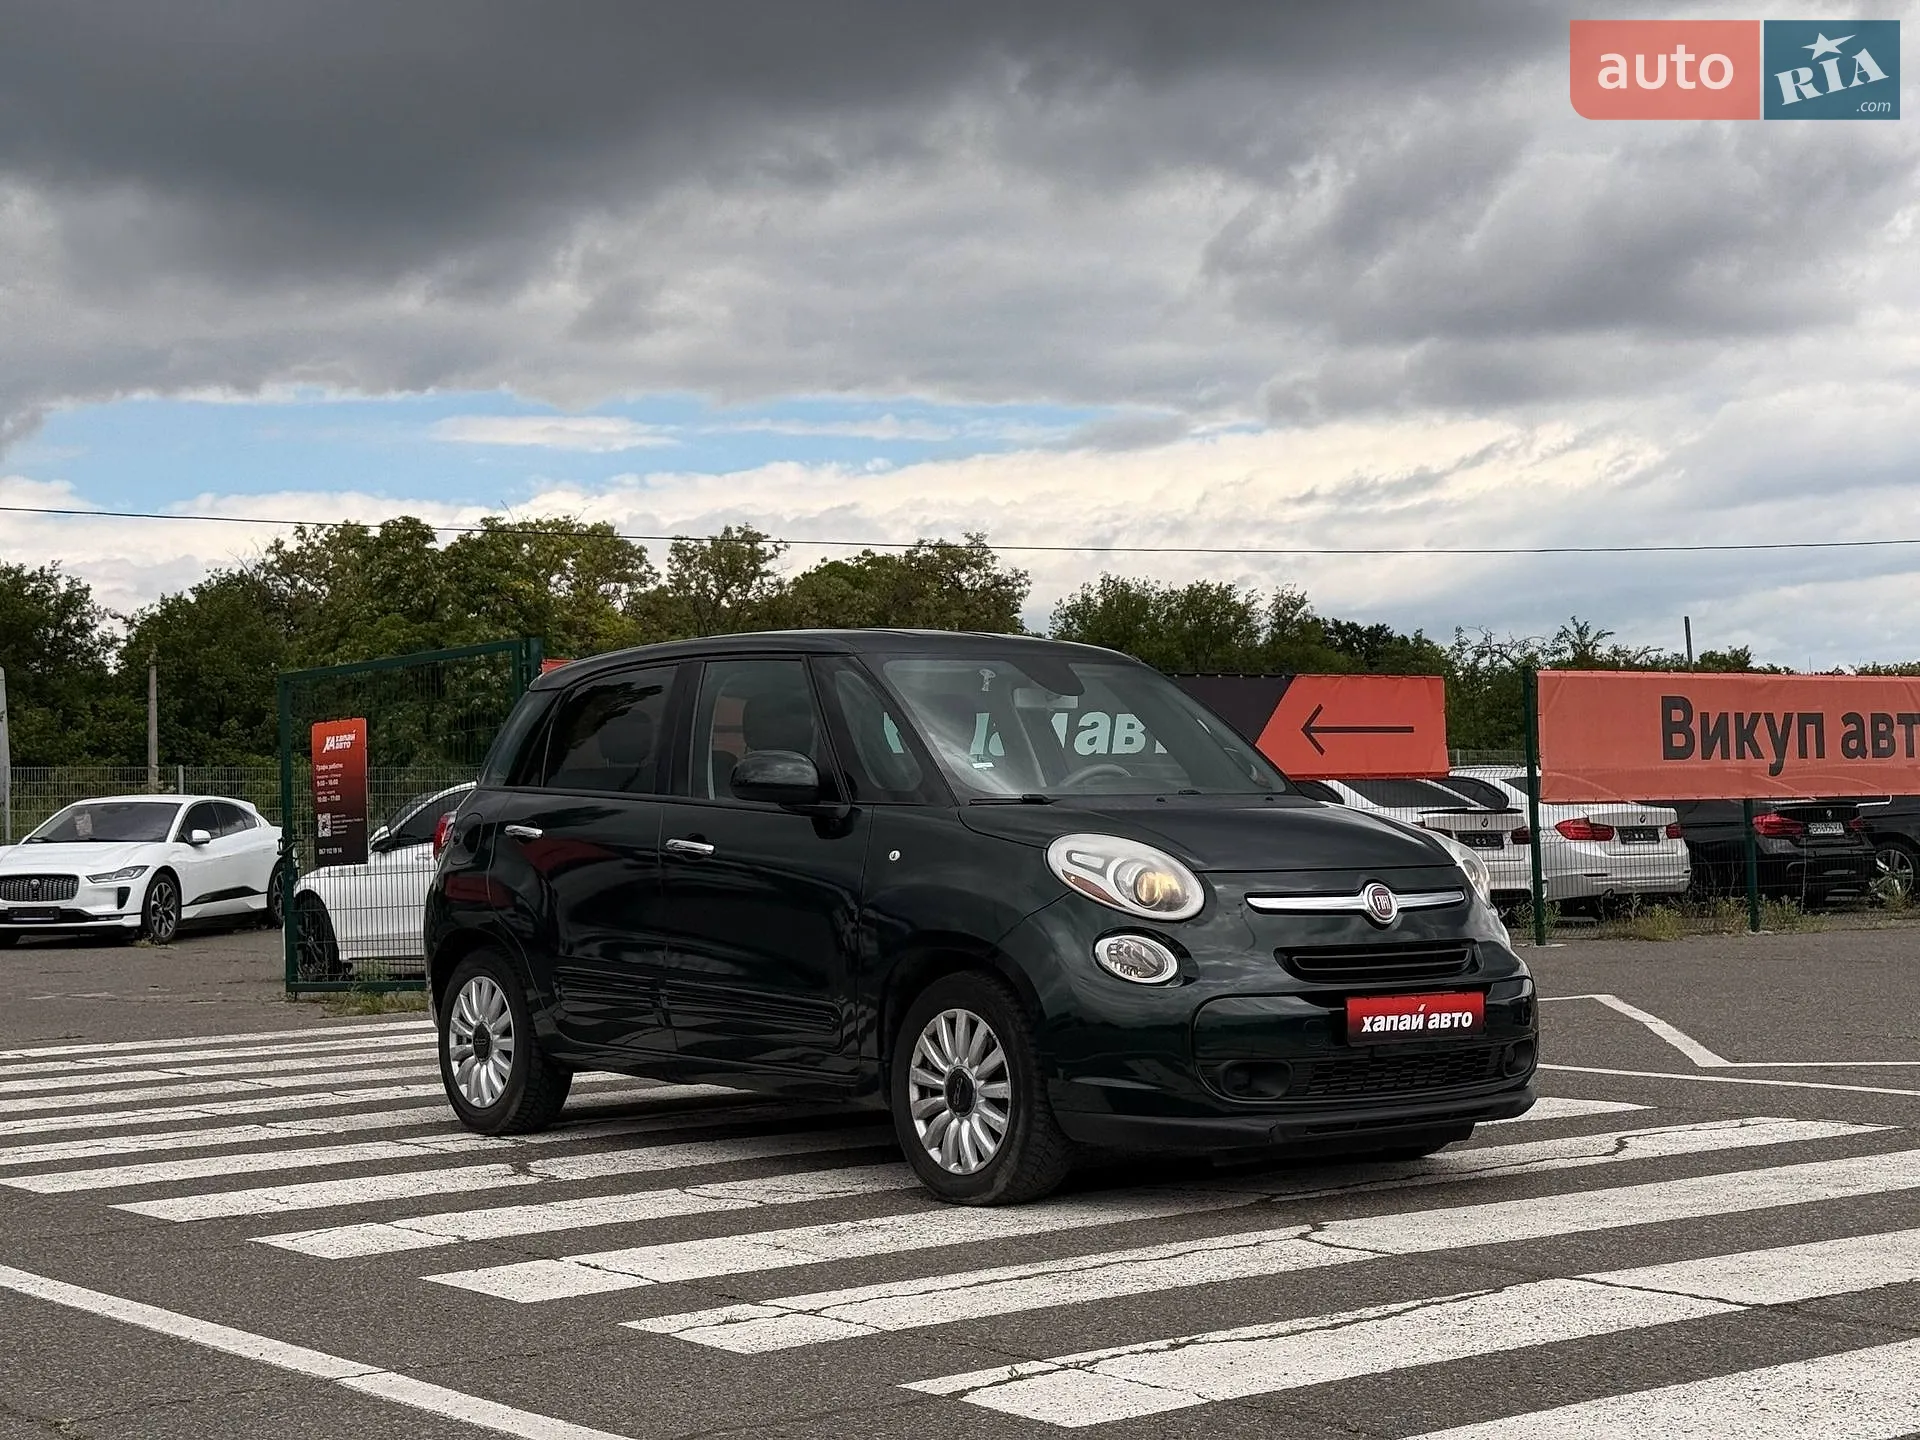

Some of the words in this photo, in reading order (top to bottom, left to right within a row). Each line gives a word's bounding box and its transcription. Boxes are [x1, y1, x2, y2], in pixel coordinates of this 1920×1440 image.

[1661, 695, 1826, 776] Викуп
[1841, 711, 1920, 759] авт
[1427, 1011, 1473, 1030] авто
